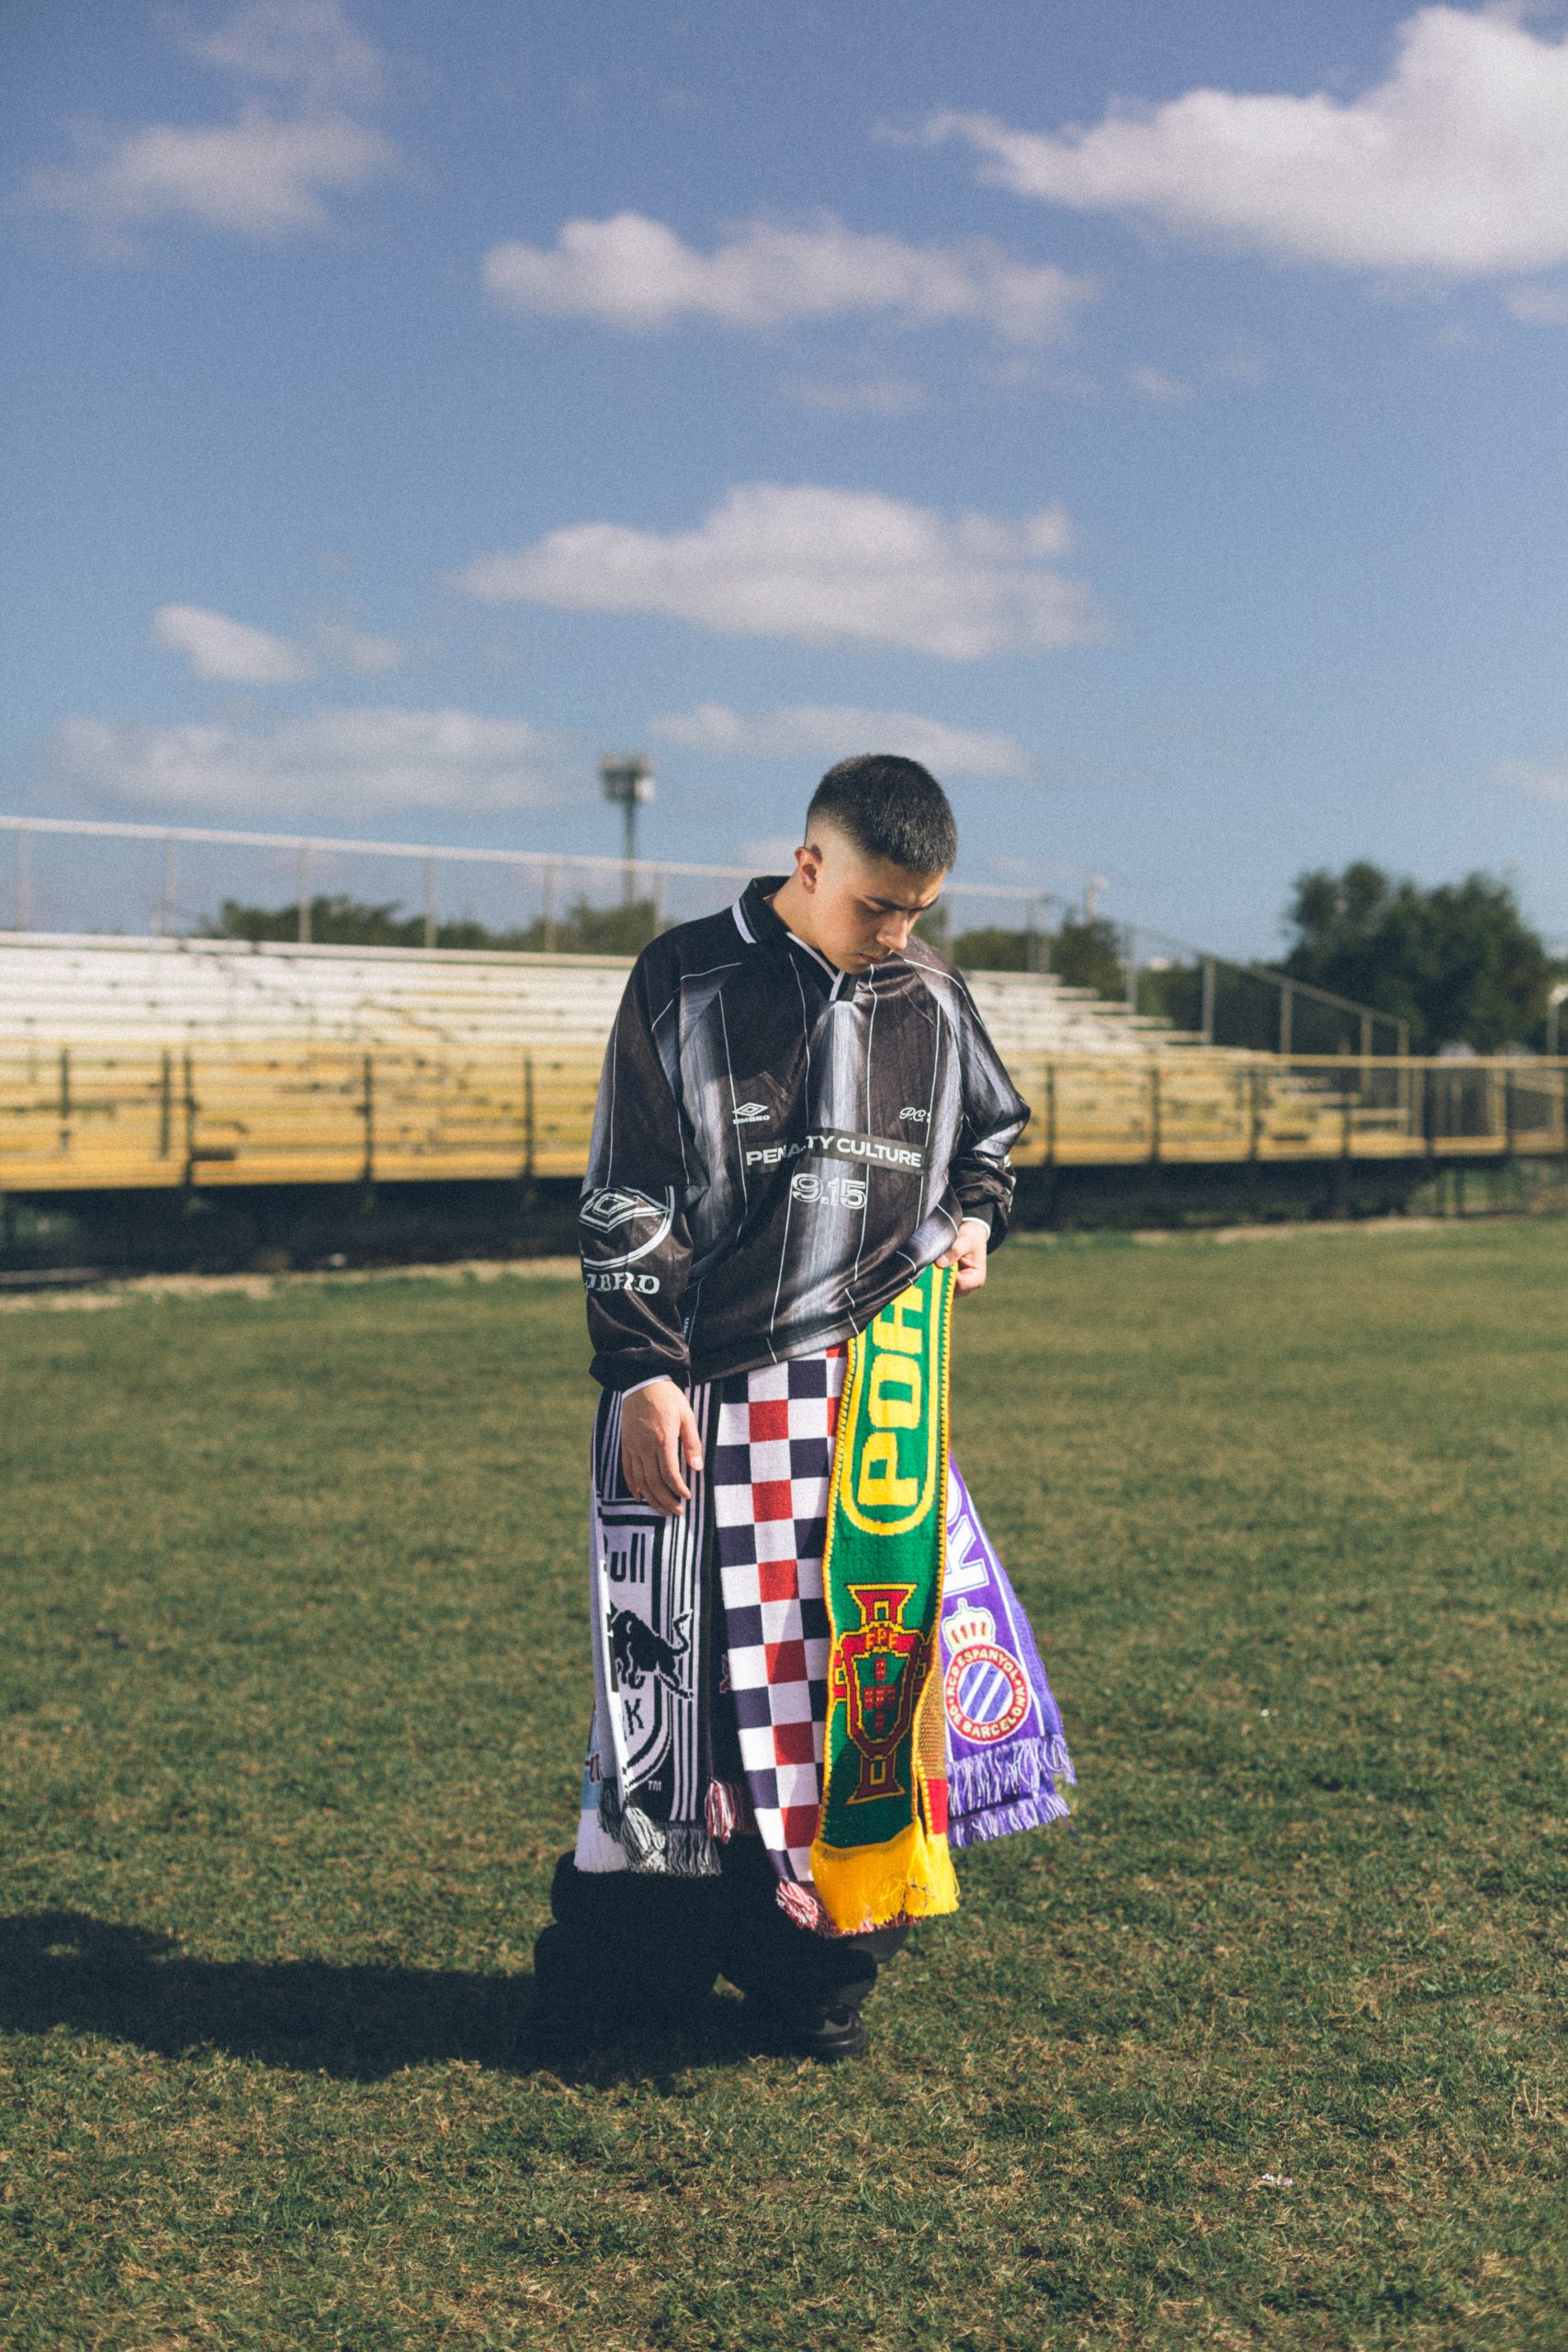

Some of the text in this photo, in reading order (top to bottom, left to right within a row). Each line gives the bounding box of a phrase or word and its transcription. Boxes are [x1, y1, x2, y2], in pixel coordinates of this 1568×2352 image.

[732, 1114, 771, 1125] UMBRO
[745, 1135, 922, 1168] PENATY CULTURE
[791, 1172, 867, 1210] 9.15
[604, 1532, 646, 1584] ull
[865, 1627, 897, 1650] FPF
[946, 1648, 1021, 1697] RCD ESPANYOL
[962, 1686, 1026, 1739] BARCELONA
[648, 1780, 662, 1792] TM
